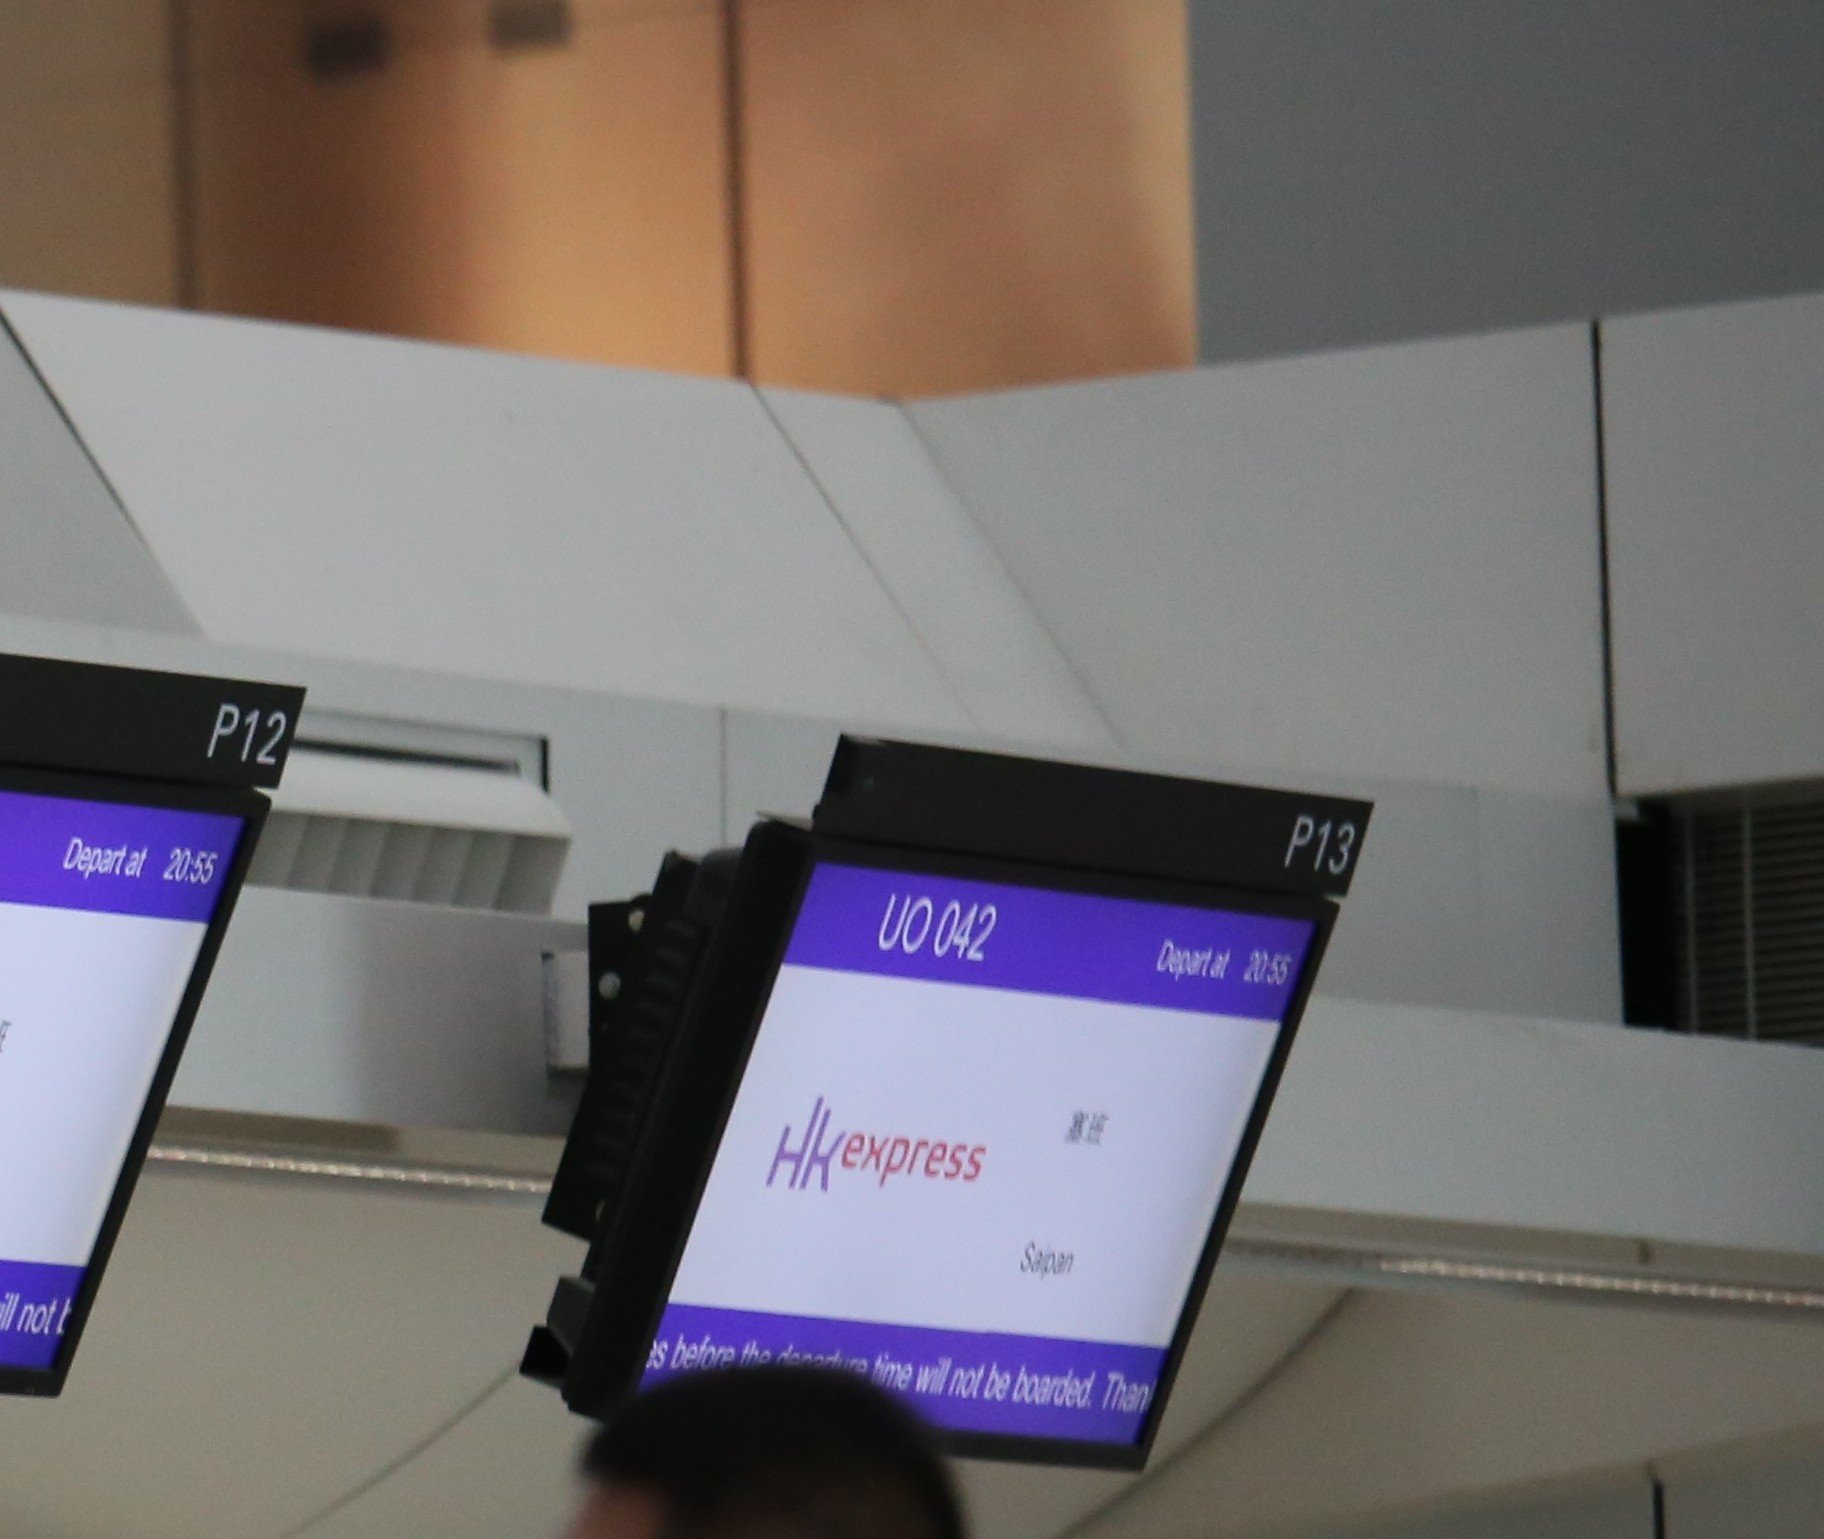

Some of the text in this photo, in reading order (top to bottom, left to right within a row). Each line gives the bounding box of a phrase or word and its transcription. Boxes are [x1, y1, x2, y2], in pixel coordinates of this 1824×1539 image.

[207, 702, 288, 766] P12
[63, 836, 218, 885] Depart at 20:55
[1284, 814, 1355, 876] P13
[878, 892, 997, 962] UO 042
[17, 1297, 58, 1336] not
[670, 1332, 736, 1371] before
[948, 1361, 985, 1400] not
[983, 1361, 1012, 1401] be
